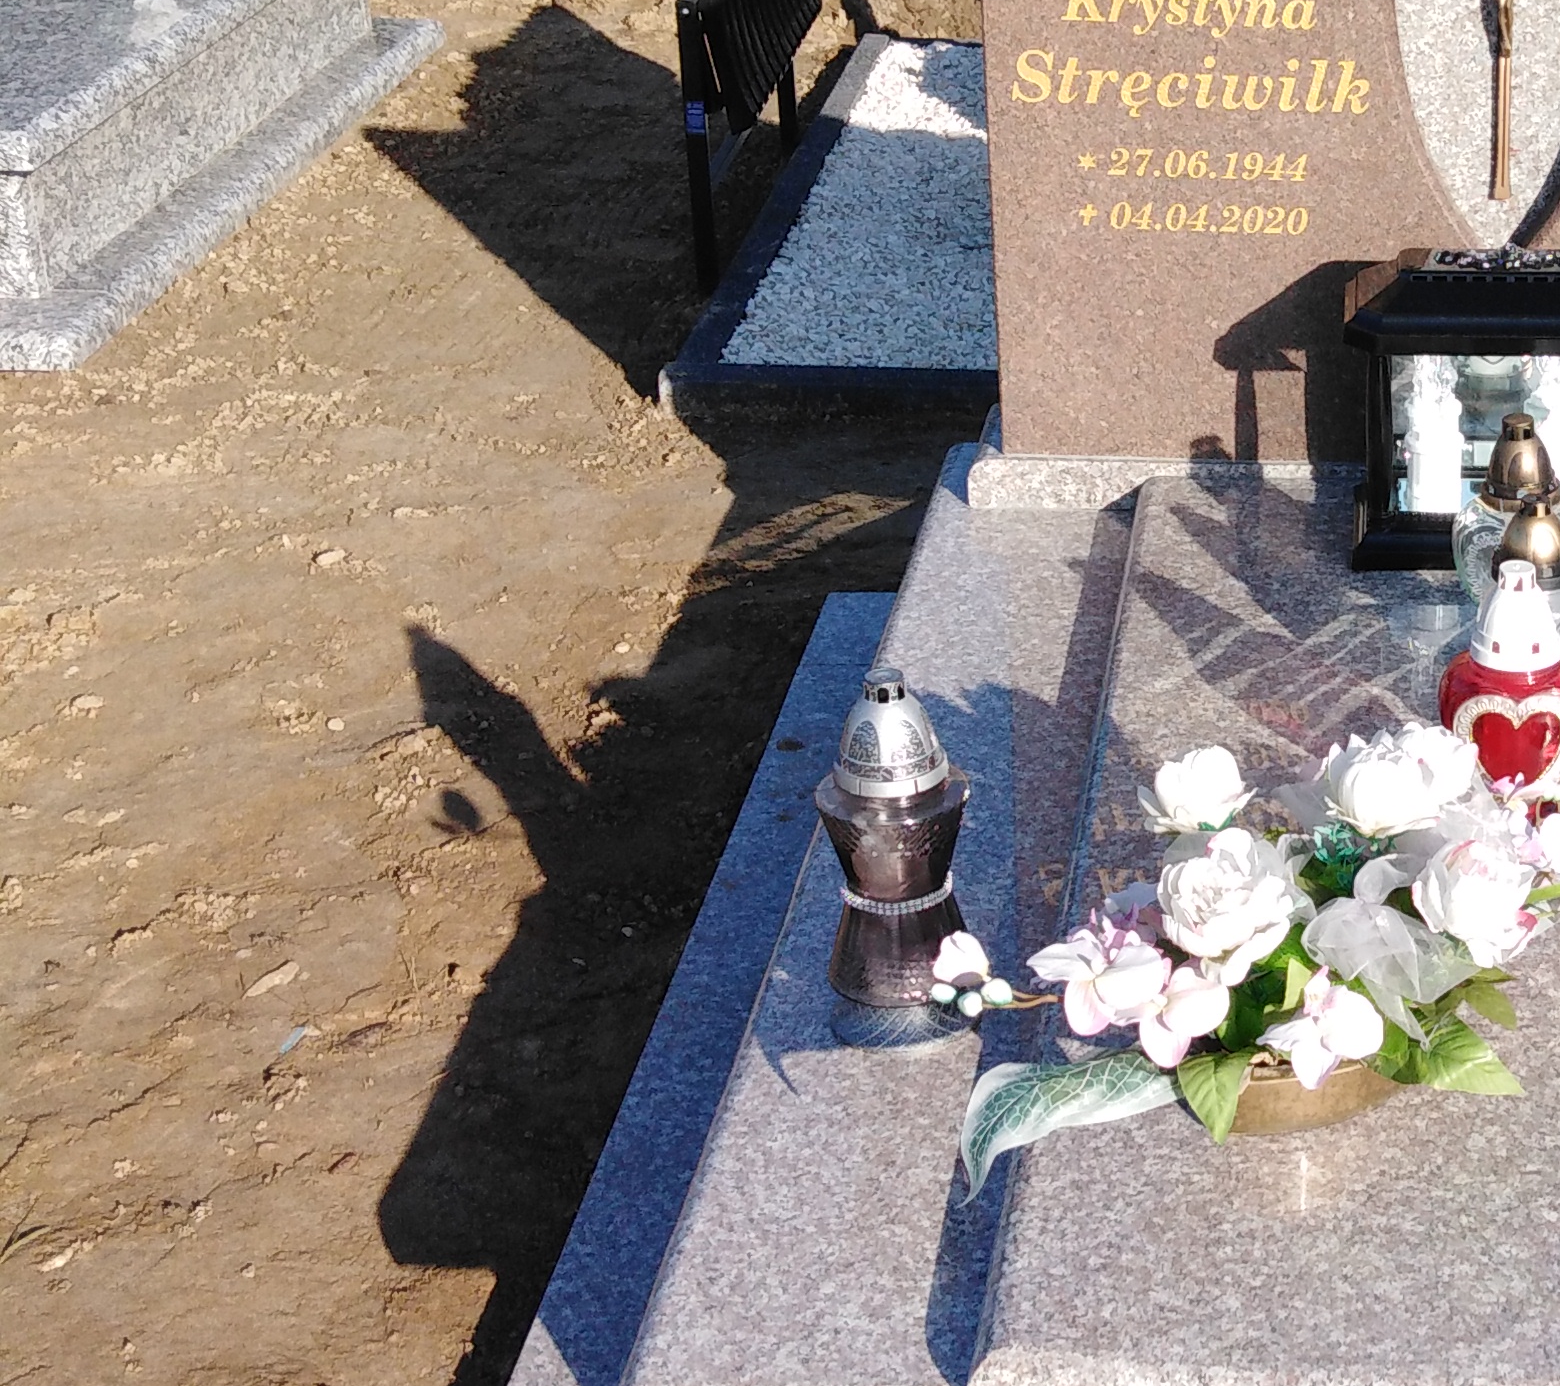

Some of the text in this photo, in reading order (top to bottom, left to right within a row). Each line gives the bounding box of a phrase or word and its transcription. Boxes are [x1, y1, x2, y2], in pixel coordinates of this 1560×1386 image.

[1010, 48, 1372, 119] Stręciwilk
[1106, 146, 1309, 182] 27.06.1944
[1109, 201, 1310, 236] 04.04.2020
